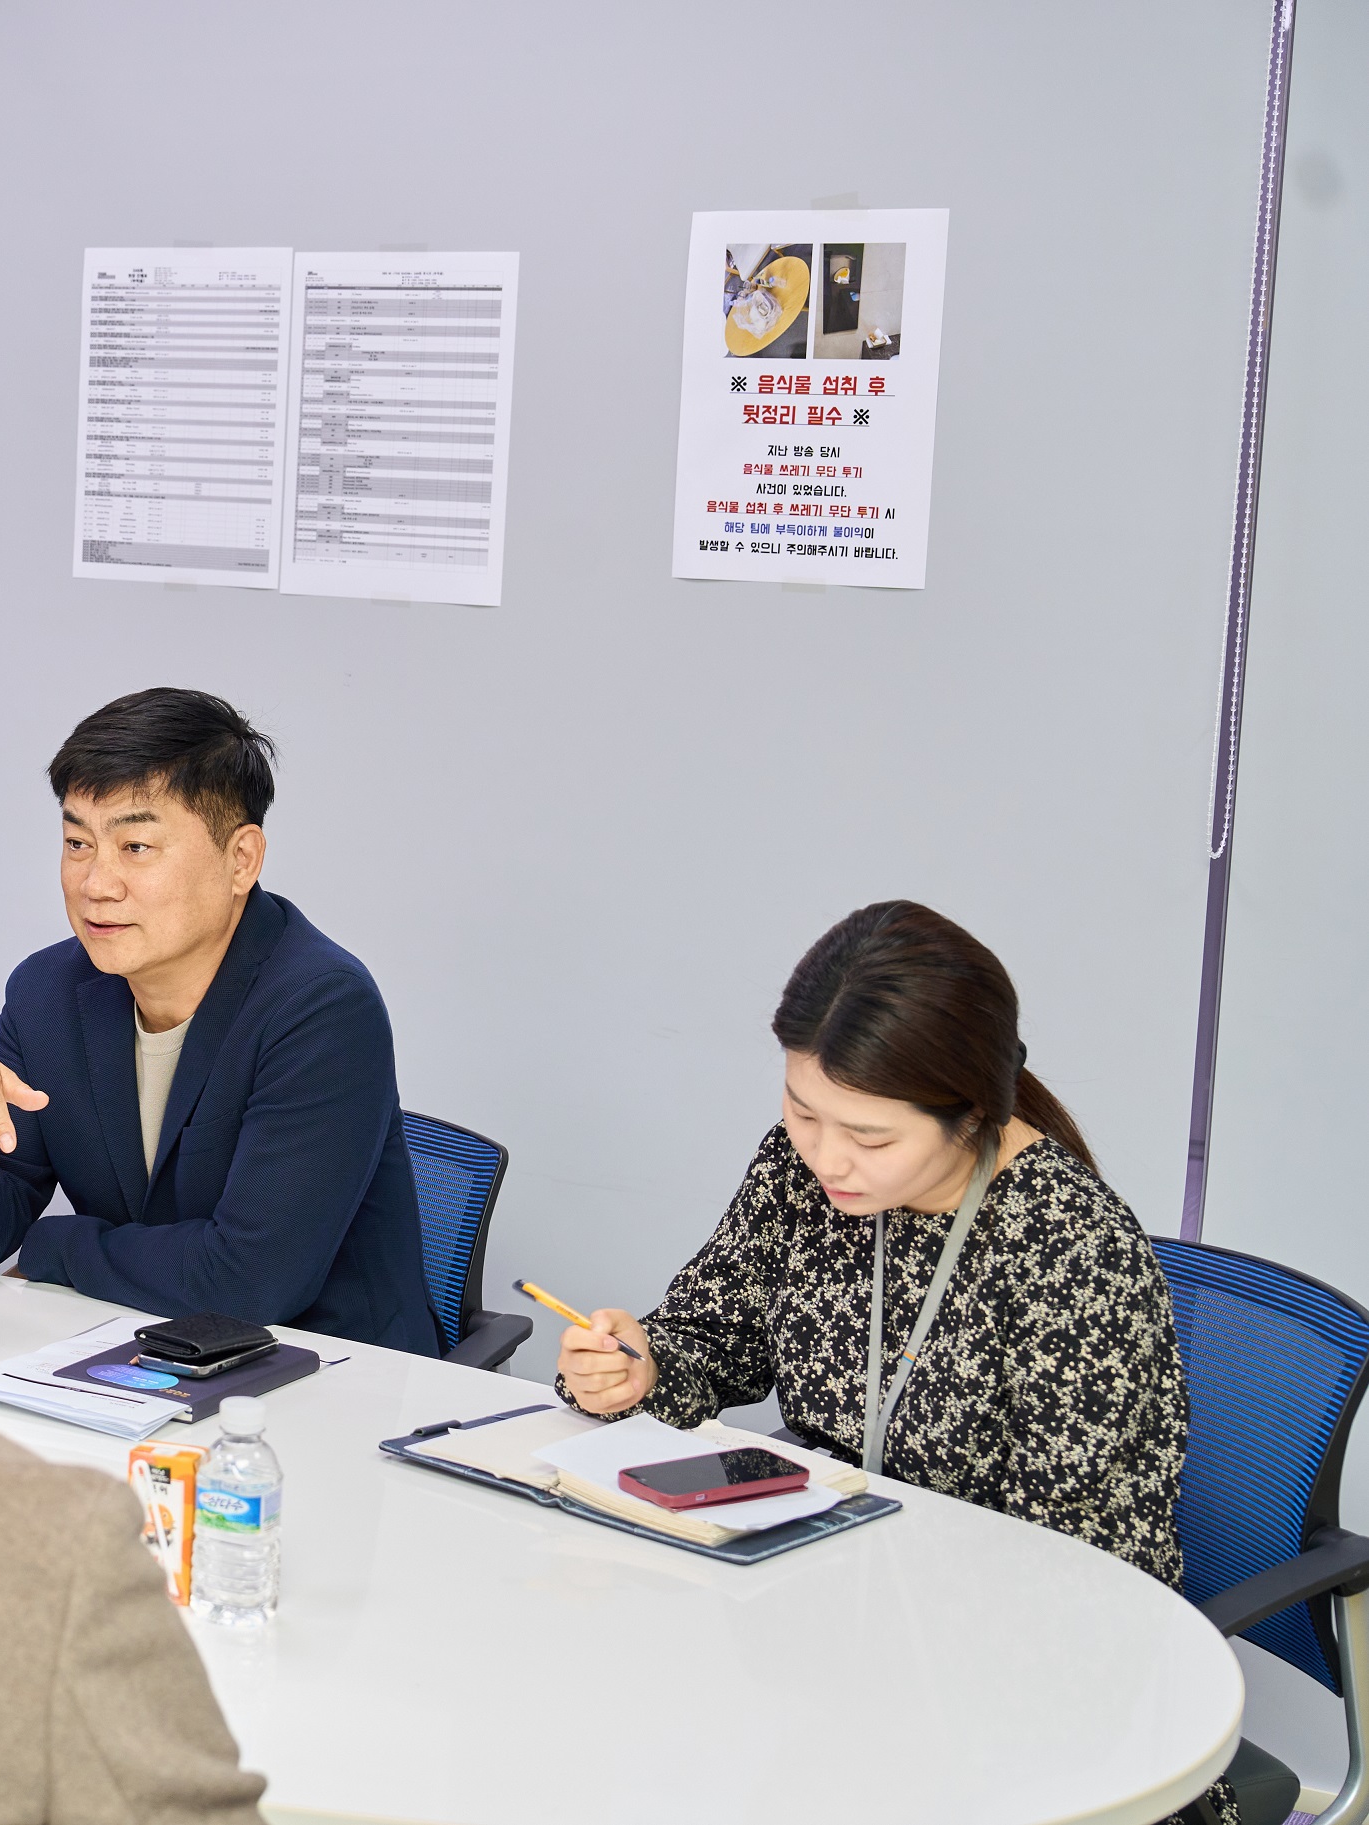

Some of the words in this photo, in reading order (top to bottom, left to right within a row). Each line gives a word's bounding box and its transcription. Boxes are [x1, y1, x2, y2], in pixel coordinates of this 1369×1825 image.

[758, 375, 811, 394] 음식물
[822, 376, 857, 395] 섭취
[868, 376, 885, 396] 후
[742, 405, 796, 424] 뒷정리
[807, 406, 842, 425] 필수
[767, 445, 787, 456] 지난
[793, 446, 813, 457] 방송
[819, 447, 840, 457] 당시
[743, 464, 773, 475] 음식물
[779, 465, 809, 476] 쓰레기
[816, 466, 836, 476] 무단
[842, 467, 861, 477] 투기
[755, 484, 786, 494] 사건이
[792, 485, 846, 497] 있었습니다.
[706, 501, 738, 513] 음식물
[745, 502, 767, 514] 섭취
[773, 504, 783, 514] 후
[790, 504, 821, 516] 쓰레기
[829, 506, 851, 518] 무단
[857, 507, 879, 518] 투기
[884, 508, 895, 519] 시
[725, 522, 743, 532] 해당
[750, 523, 769, 534] 팀에
[776, 525, 827, 535] 부득이하게
[833, 527, 874, 539] 불이익이
[699, 540, 729, 551] 발생할
[734, 542, 744, 552] 수
[750, 542, 780, 554] 있으니
[786, 544, 848, 557] 주의해주시기
[853, 547, 898, 559] 바랍니다.
[208, 1496, 244, 1511] 삼다수
